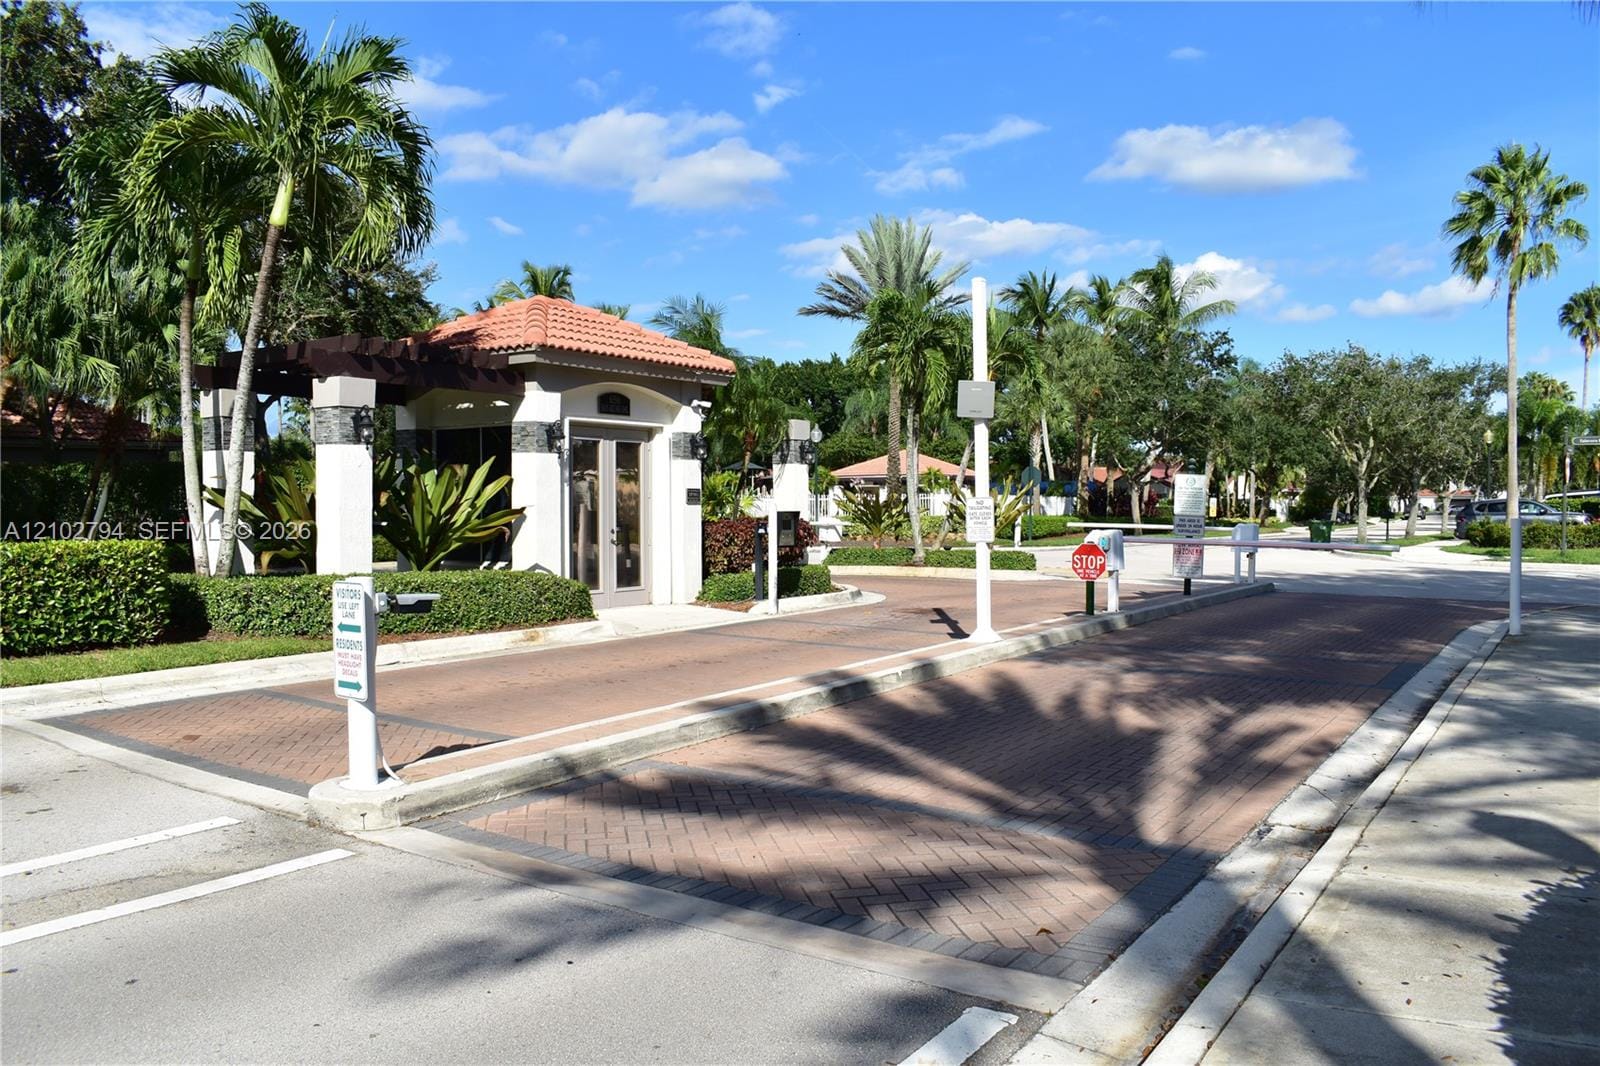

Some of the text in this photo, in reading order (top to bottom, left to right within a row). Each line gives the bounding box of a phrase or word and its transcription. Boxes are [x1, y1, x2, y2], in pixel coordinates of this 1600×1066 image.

[1073, 555, 1104, 569] STOP
[336, 588, 361, 600] VISITORS
[342, 611, 355, 619] LANE
[336, 638, 363, 651] RESIDENTS
[338, 660, 362, 669] HEADLIGHT
[342, 668, 358, 676] DECALS
